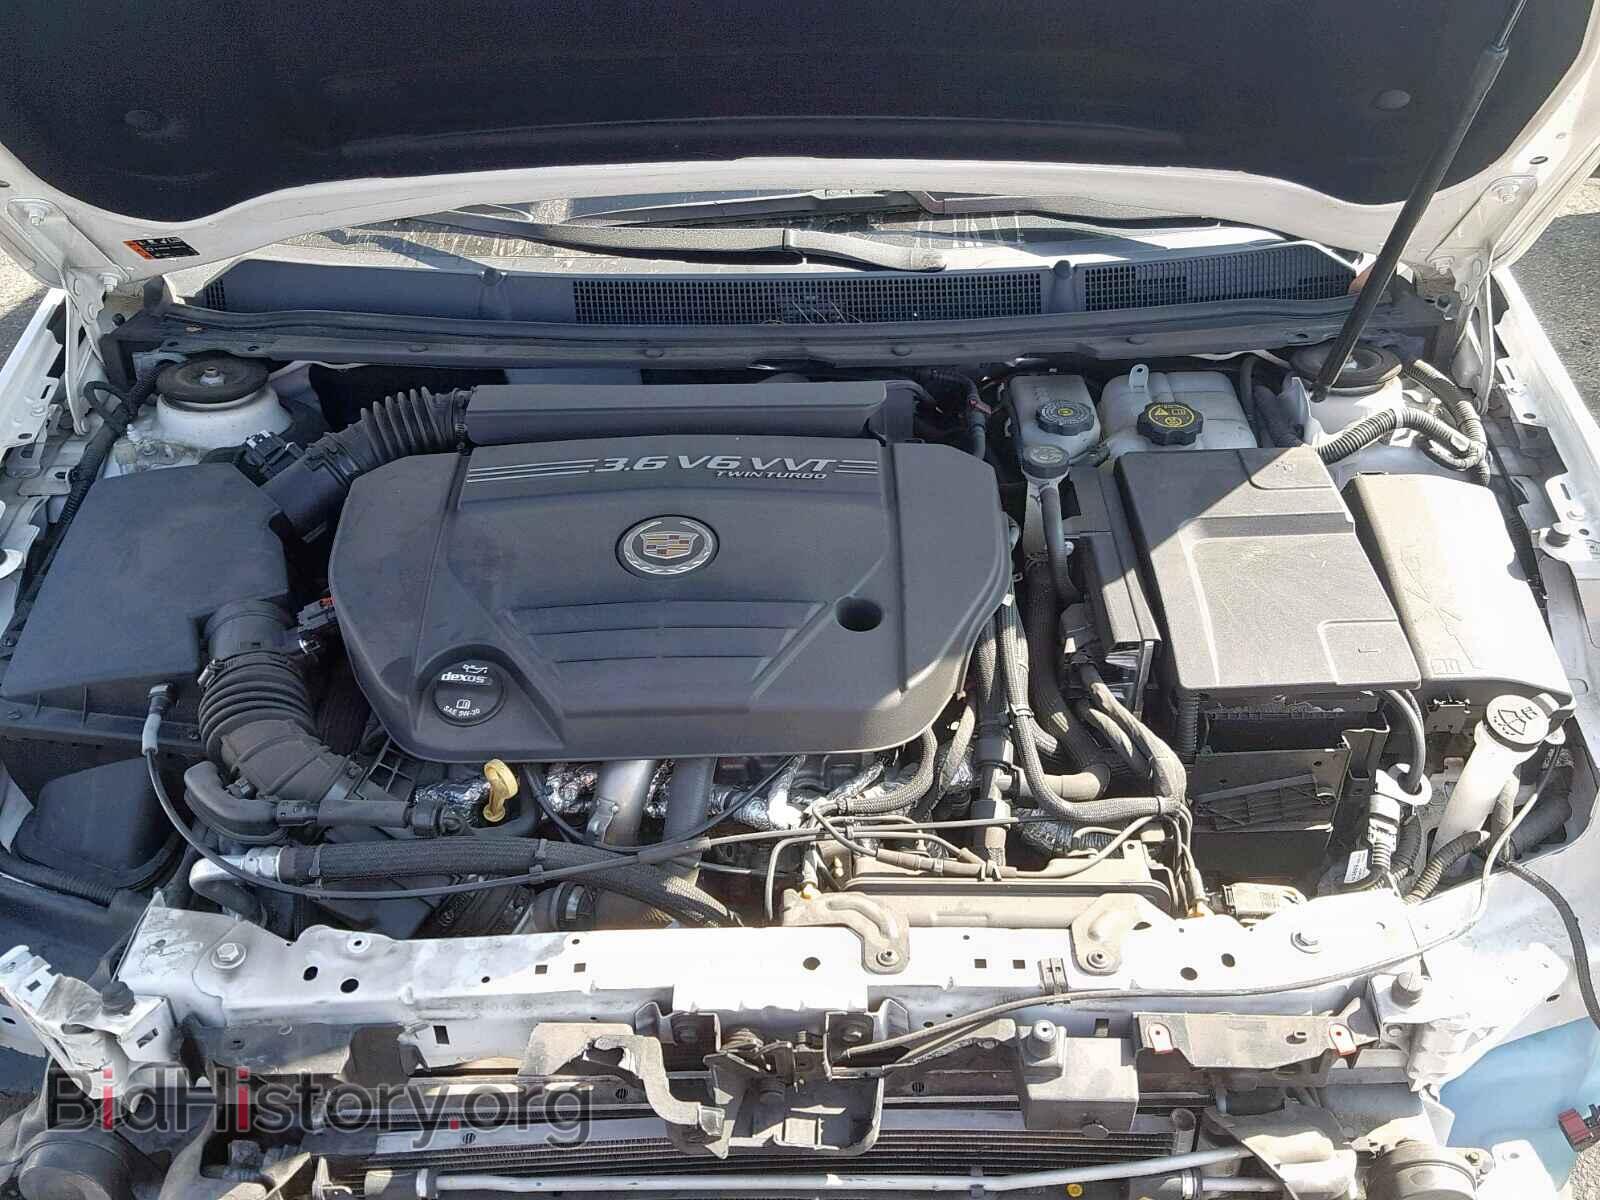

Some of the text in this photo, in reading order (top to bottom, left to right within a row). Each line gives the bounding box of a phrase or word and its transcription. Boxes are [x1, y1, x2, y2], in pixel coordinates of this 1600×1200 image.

[594, 455, 837, 473] 3.6 V6 VVT
[441, 672, 489, 684] dexos
